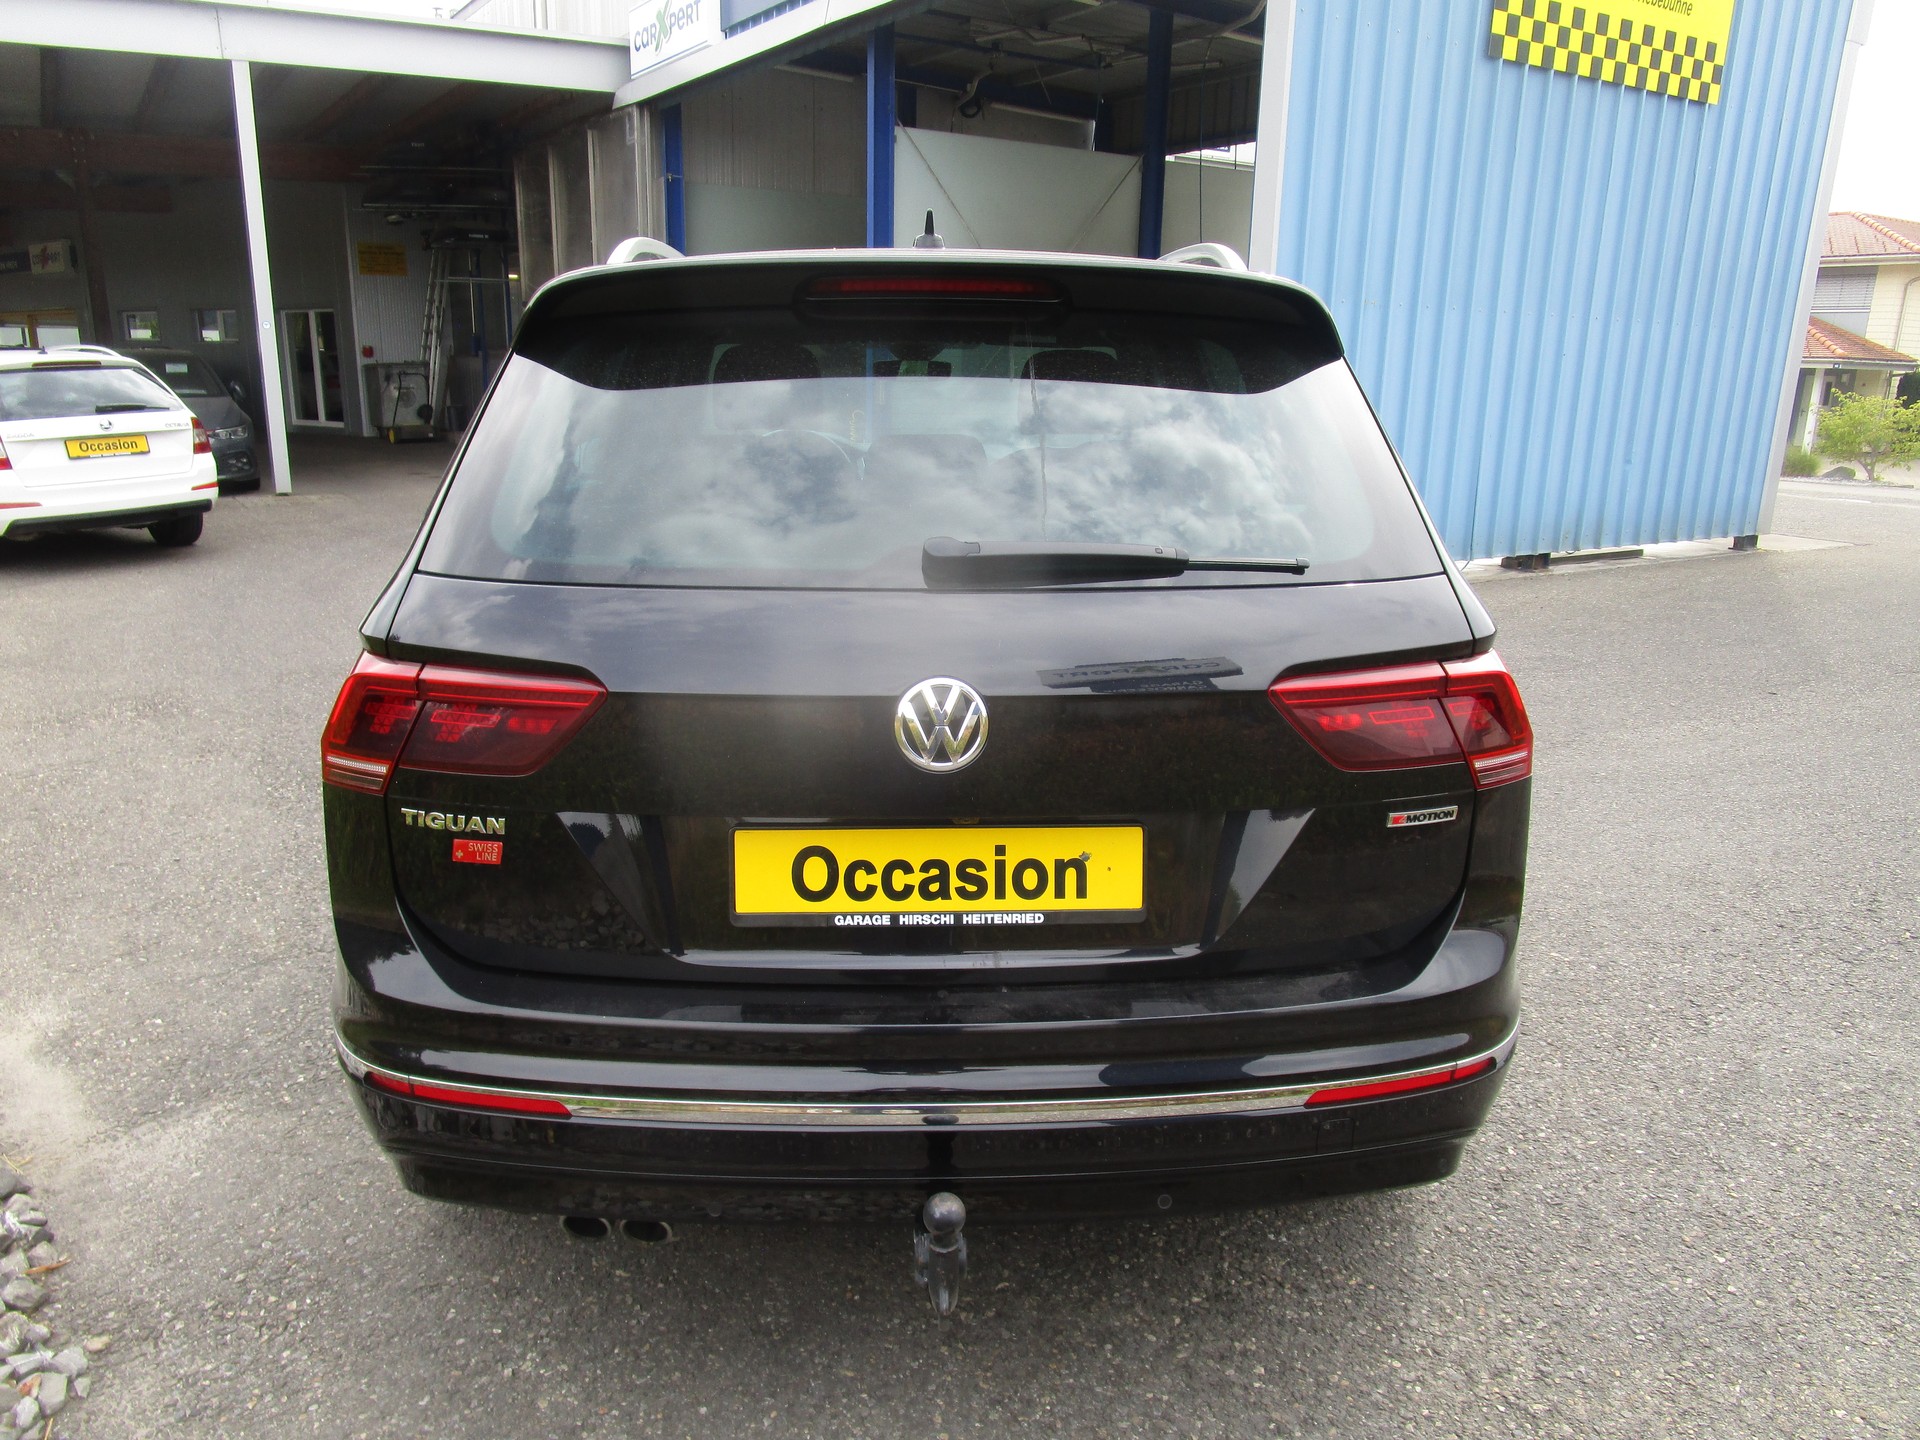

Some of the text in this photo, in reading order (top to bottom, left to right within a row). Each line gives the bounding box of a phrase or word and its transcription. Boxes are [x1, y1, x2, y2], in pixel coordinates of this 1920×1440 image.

[78, 439, 139, 453] Occasion
[400, 807, 506, 835] TIGUAN
[468, 842, 499, 852] SWISS
[476, 851, 498, 862] LINE
[791, 844, 1089, 902] Occasion
[834, 913, 1046, 927] GARAGE HIRSCHI HEITENRIED
